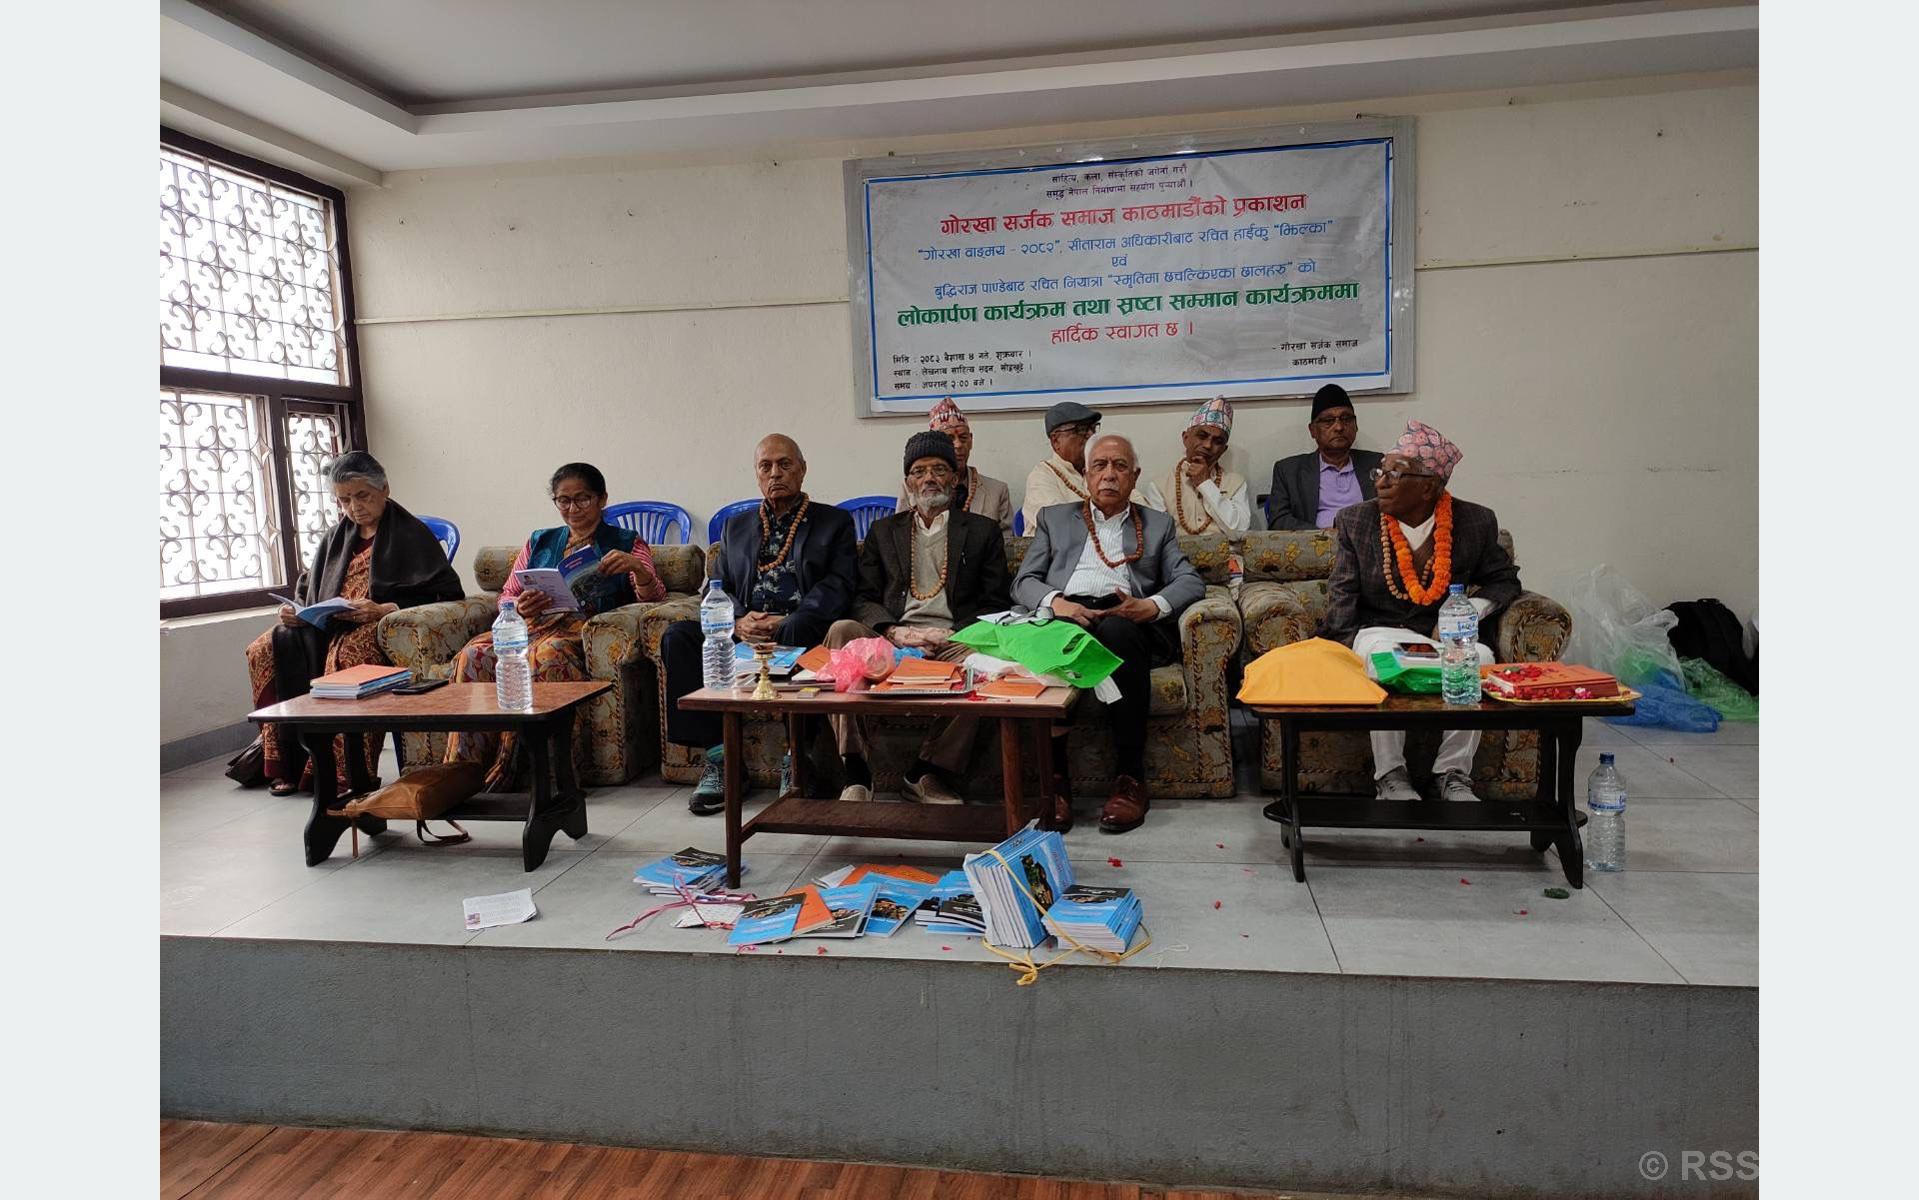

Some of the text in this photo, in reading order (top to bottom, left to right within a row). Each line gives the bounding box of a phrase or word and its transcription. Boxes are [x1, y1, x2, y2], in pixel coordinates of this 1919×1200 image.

[941, 214, 995, 235] गोरखा
[1003, 208, 1053, 231] सर्जक
[1061, 207, 1115, 226] समाज
[1233, 193, 1307, 217] प्रकाशन
[1068, 237, 1116, 251] सीताराम
[1121, 230, 1193, 248] अधिकारीबाट
[1199, 230, 1228, 242] रचित
[1111, 254, 1127, 267] एवं
[1031, 278, 1058, 291] रचित
[1297, 258, 1315, 273] को
[898, 304, 978, 327] लोकार्पण
[984, 299, 1065, 321] कार्यक्रम
[1073, 299, 1110, 316] तथा
[1169, 291, 1238, 310] सम्मान
[1246, 283, 1359, 305] कार्यक्रममा
[1051, 323, 1098, 344] हार्दिक
[1106, 322, 1159, 339] स्वागत
[1165, 322, 1178, 336] छ
